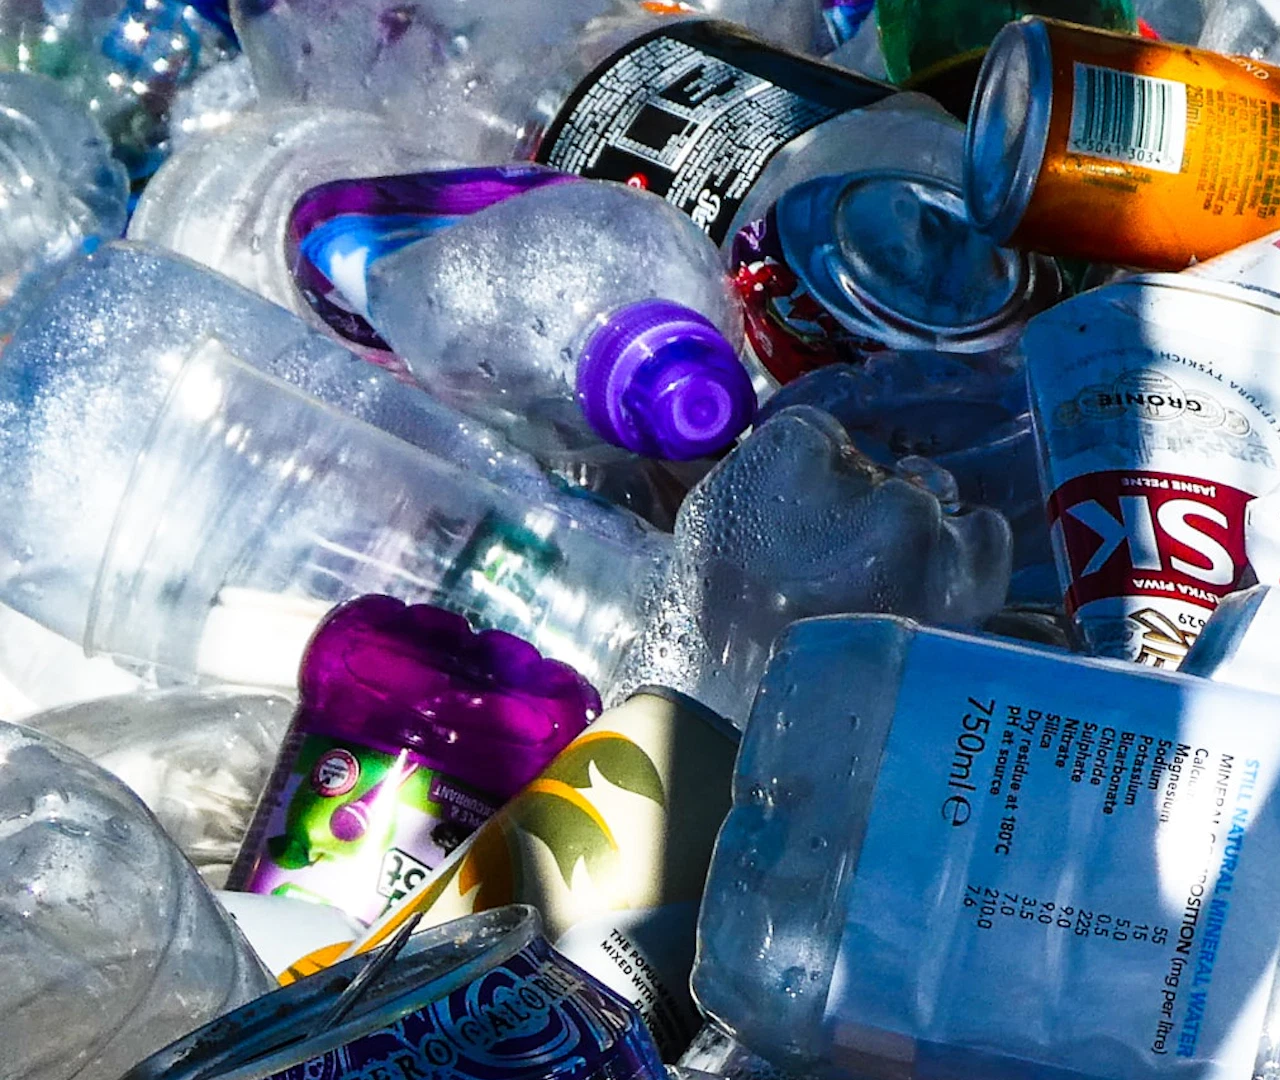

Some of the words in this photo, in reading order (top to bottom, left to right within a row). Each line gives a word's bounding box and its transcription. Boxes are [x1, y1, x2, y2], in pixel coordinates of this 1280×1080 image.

[1158, 350, 1226, 383] TYSKICH
[1098, 391, 1203, 413] GRONIE
[1171, 480, 1217, 498] JASNE
[1132, 578, 1177, 592] PIWA
[1002, 704, 1021, 728] pH
[1019, 708, 1040, 735] Dry
[1038, 712, 1060, 750] Silica
[946, 693, 995, 792] 750ml
[1000, 729, 1016, 746] at
[1053, 716, 1078, 769] Nitrate
[1068, 720, 1096, 784] Sulphate
[1007, 736, 1033, 792] residue
[1088, 725, 1115, 787] Chloride
[1123, 734, 1152, 807] Potassium
[1146, 738, 1172, 792] Sodium
[988, 747, 1011, 797] source
[1101, 730, 1133, 816] Bicarbonate
[1235, 756, 1260, 803] STILL
[1003, 793, 1021, 813] at
[1212, 805, 1249, 896] NATURAL
[961, 883, 980, 909] 7.6
[976, 887, 999, 930] 210.0
[999, 891, 1017, 917] 7.0
[1018, 896, 1036, 921] 3.5
[1037, 901, 1055, 925] 9.0
[1055, 905, 1073, 929] 9.0
[1073, 909, 1092, 937] 225
[1093, 913, 1111, 938] 0.5
[609, 928, 632, 952] THE
[1111, 917, 1130, 942] 5.0
[1131, 923, 1148, 941] 15
[1150, 925, 1168, 946] 55
[1192, 898, 1226, 988] MINERAL
[600, 940, 633, 975] MIXED
[632, 973, 656, 1004] WITH
[1165, 955, 1187, 989] (mg
[1157, 989, 1178, 1018] per
[1151, 1019, 1173, 1056] litre)
[1175, 989, 1207, 1060] WATER
